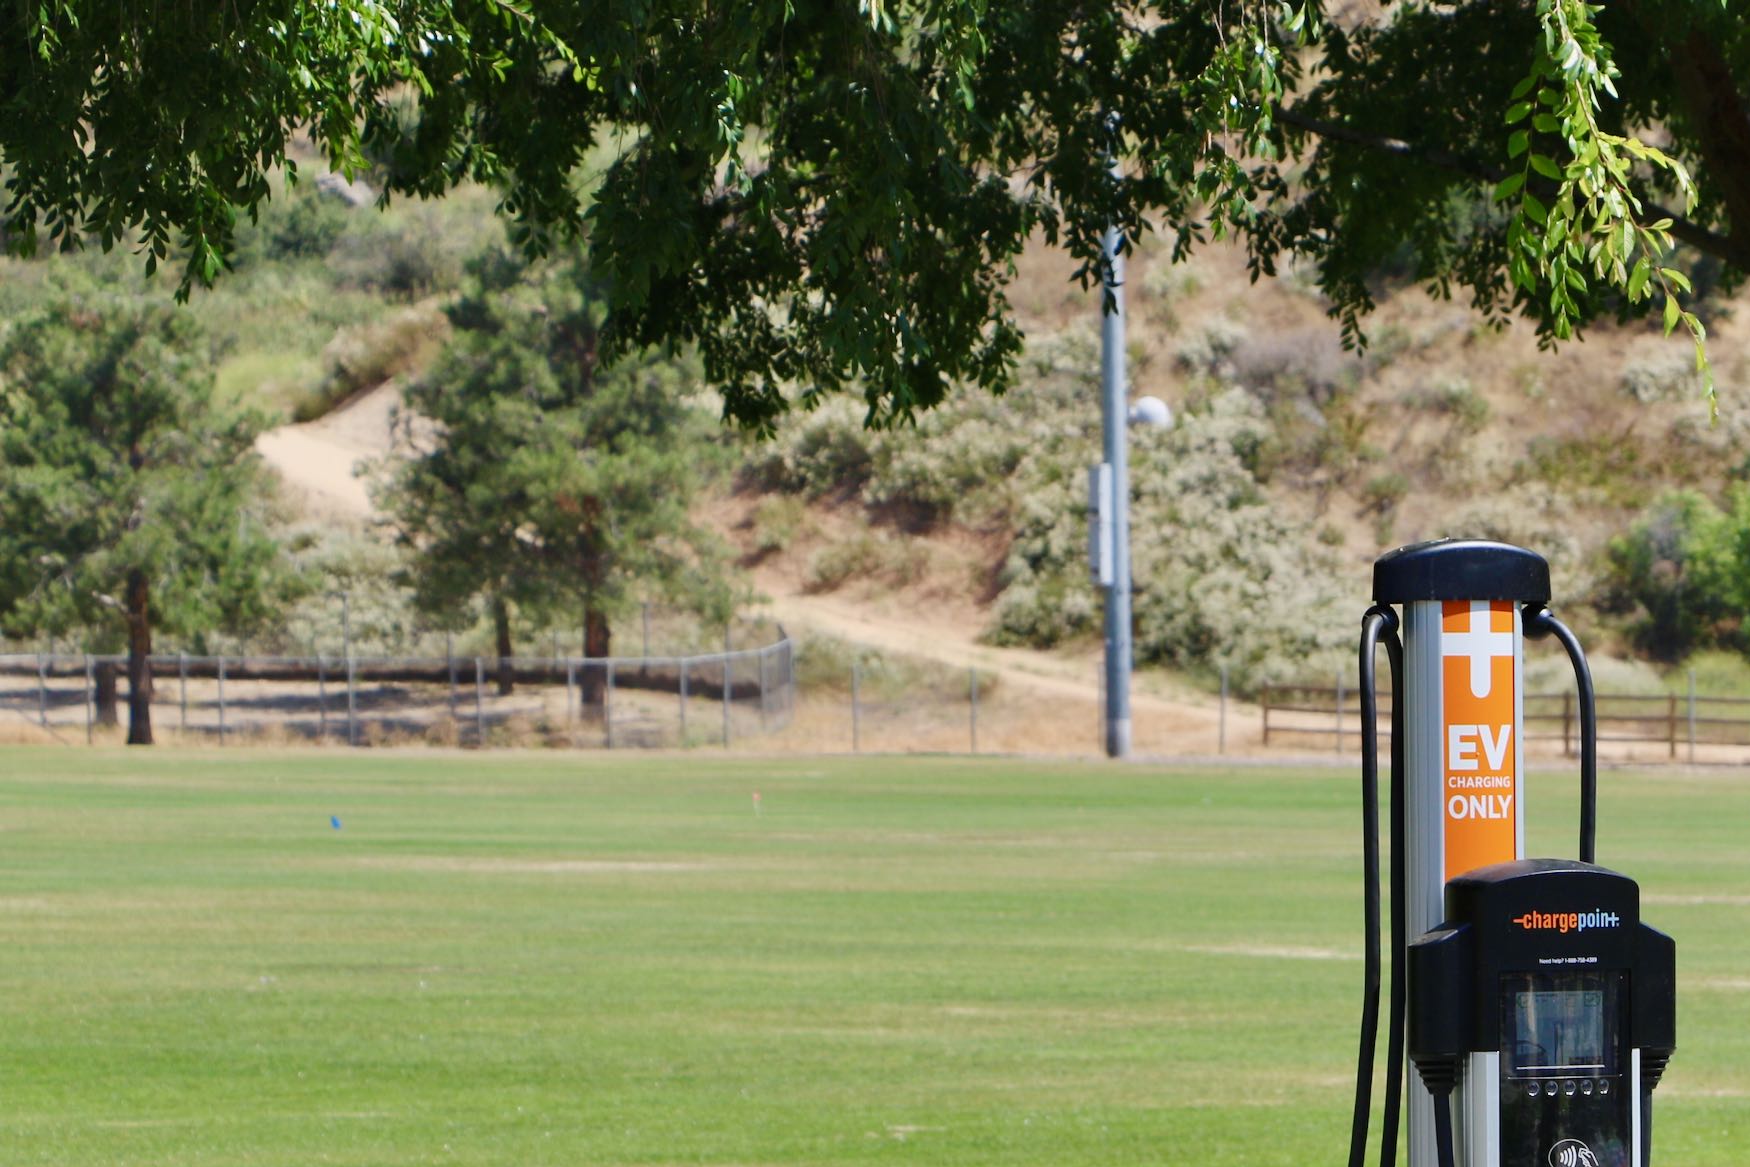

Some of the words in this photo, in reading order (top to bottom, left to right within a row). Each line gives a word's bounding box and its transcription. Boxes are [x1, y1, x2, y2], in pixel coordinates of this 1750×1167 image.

[1448, 724, 1512, 771] EV
[1448, 776, 1511, 788] CHARGING
[1448, 795, 1513, 820] ONLY
